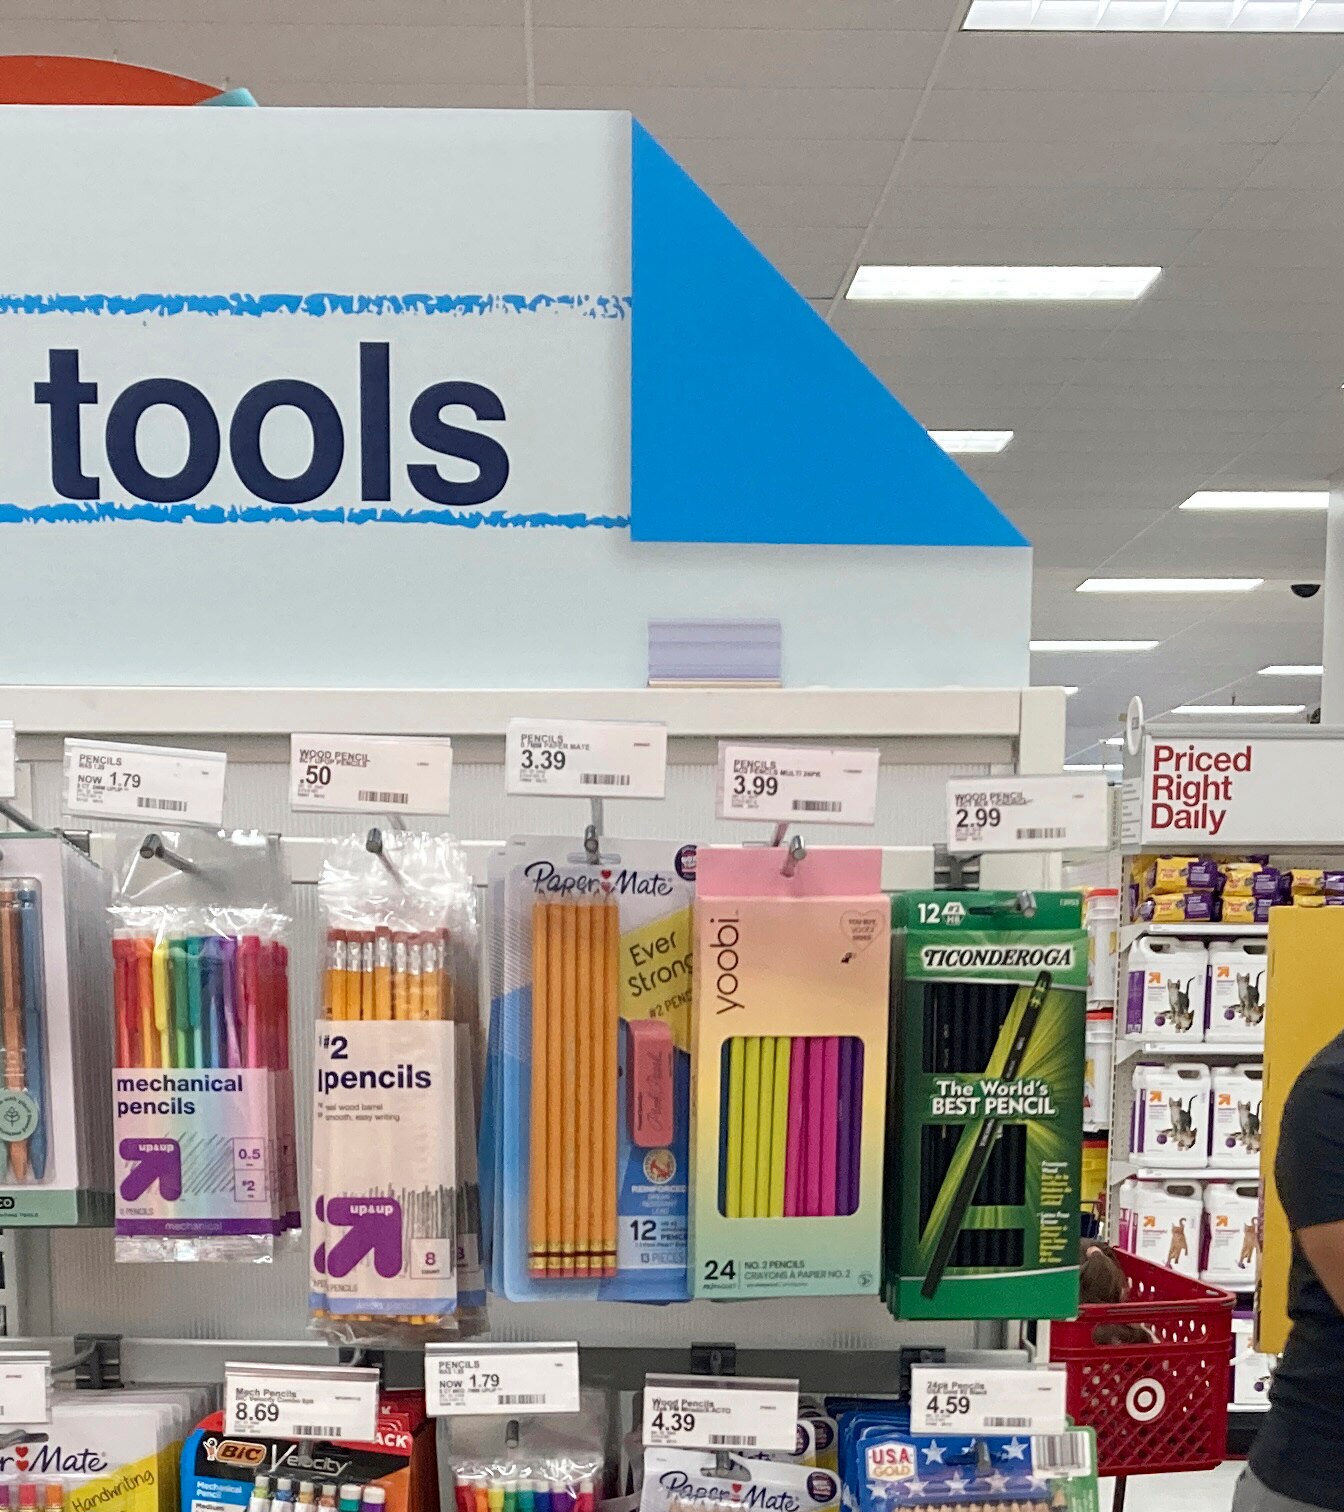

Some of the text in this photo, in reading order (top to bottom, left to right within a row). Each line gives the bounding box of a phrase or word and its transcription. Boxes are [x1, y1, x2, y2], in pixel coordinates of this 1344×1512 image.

[35, 341, 510, 505] tools
[520, 750, 566, 771] 3.39
[1154, 744, 1253, 774] Priced
[78, 772, 141, 789] NOW 1.79
[299, 766, 331, 785] .50
[733, 775, 778, 797] 3.99
[1152, 774, 1233, 806] Right
[956, 808, 1001, 829] 2.99
[1151, 803, 1227, 835] Daily
[524, 861, 674, 897] Paper Mate
[917, 904, 941, 923] 12
[629, 930, 677, 968] Ever
[923, 947, 1073, 969] TICONDEROGA
[710, 916, 746, 1016] yoobi
[116, 1074, 243, 1093] mechanical
[936, 1079, 1049, 1097] The World's
[116, 1098, 196, 1118] pencils
[932, 1097, 1056, 1116] BEST PENCIL
[238, 1148, 261, 1160] 0.5
[349, 1204, 394, 1216] up&up
[630, 1219, 657, 1241] 12
[424, 1251, 436, 1266] 8
[704, 1259, 736, 1281] 24
[439, 1373, 500, 1389] NOW 1.79
[235, 1402, 280, 1423] 8.69
[927, 1395, 971, 1416] 4.59
[651, 1412, 696, 1433] 4.39
[26, 1444, 107, 1474] Mate
[220, 1445, 263, 1463] BIC
[870, 1448, 912, 1464] USA
[659, 1470, 799, 1512] Paper Mate
